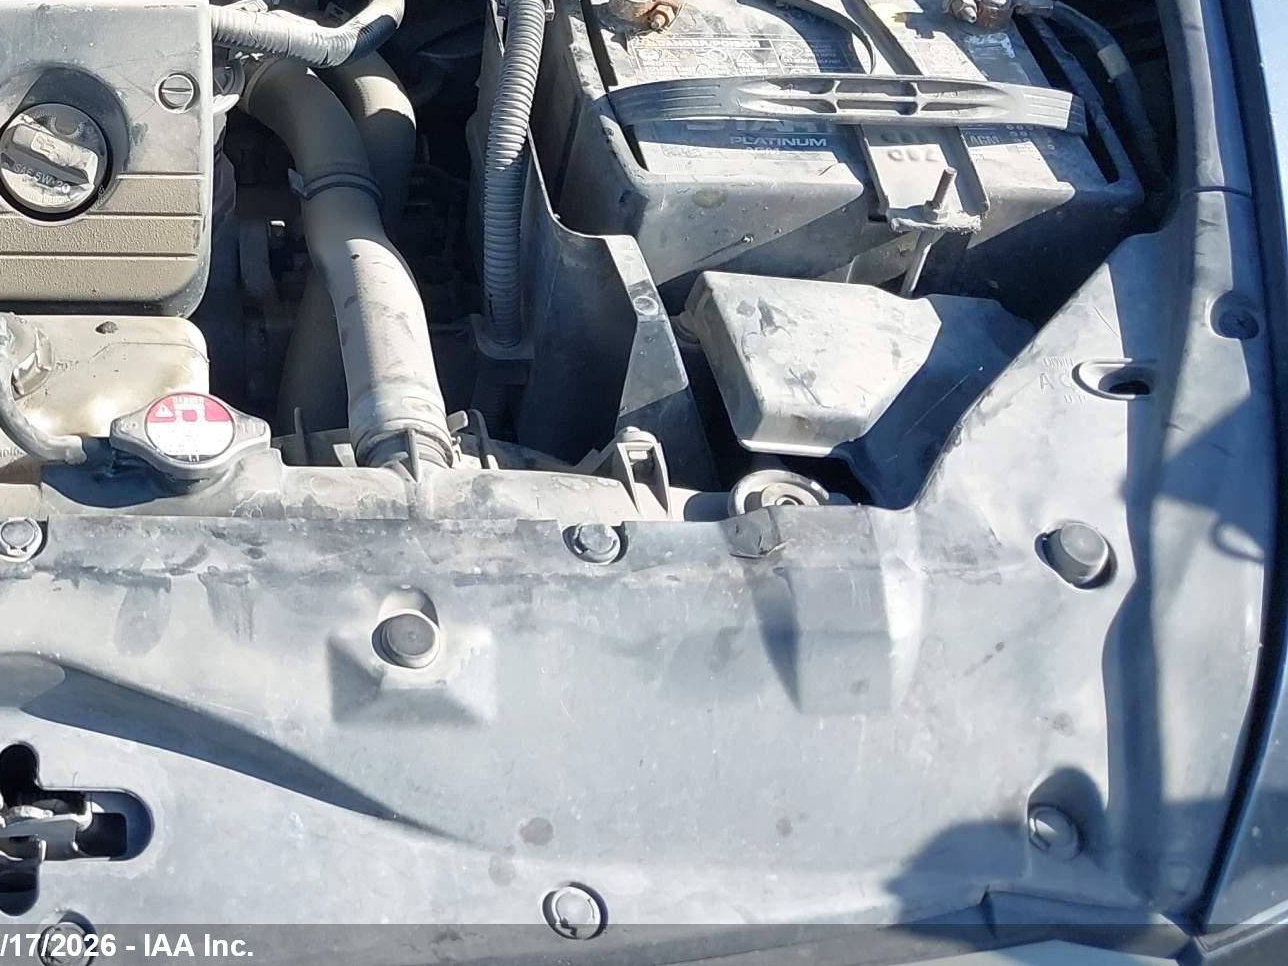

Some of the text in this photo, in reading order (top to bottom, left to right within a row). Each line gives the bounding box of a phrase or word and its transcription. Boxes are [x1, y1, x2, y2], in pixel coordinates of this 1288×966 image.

[729, 136, 827, 147] PLATINUM
[13, 162, 71, 194] SAE 5W-20
